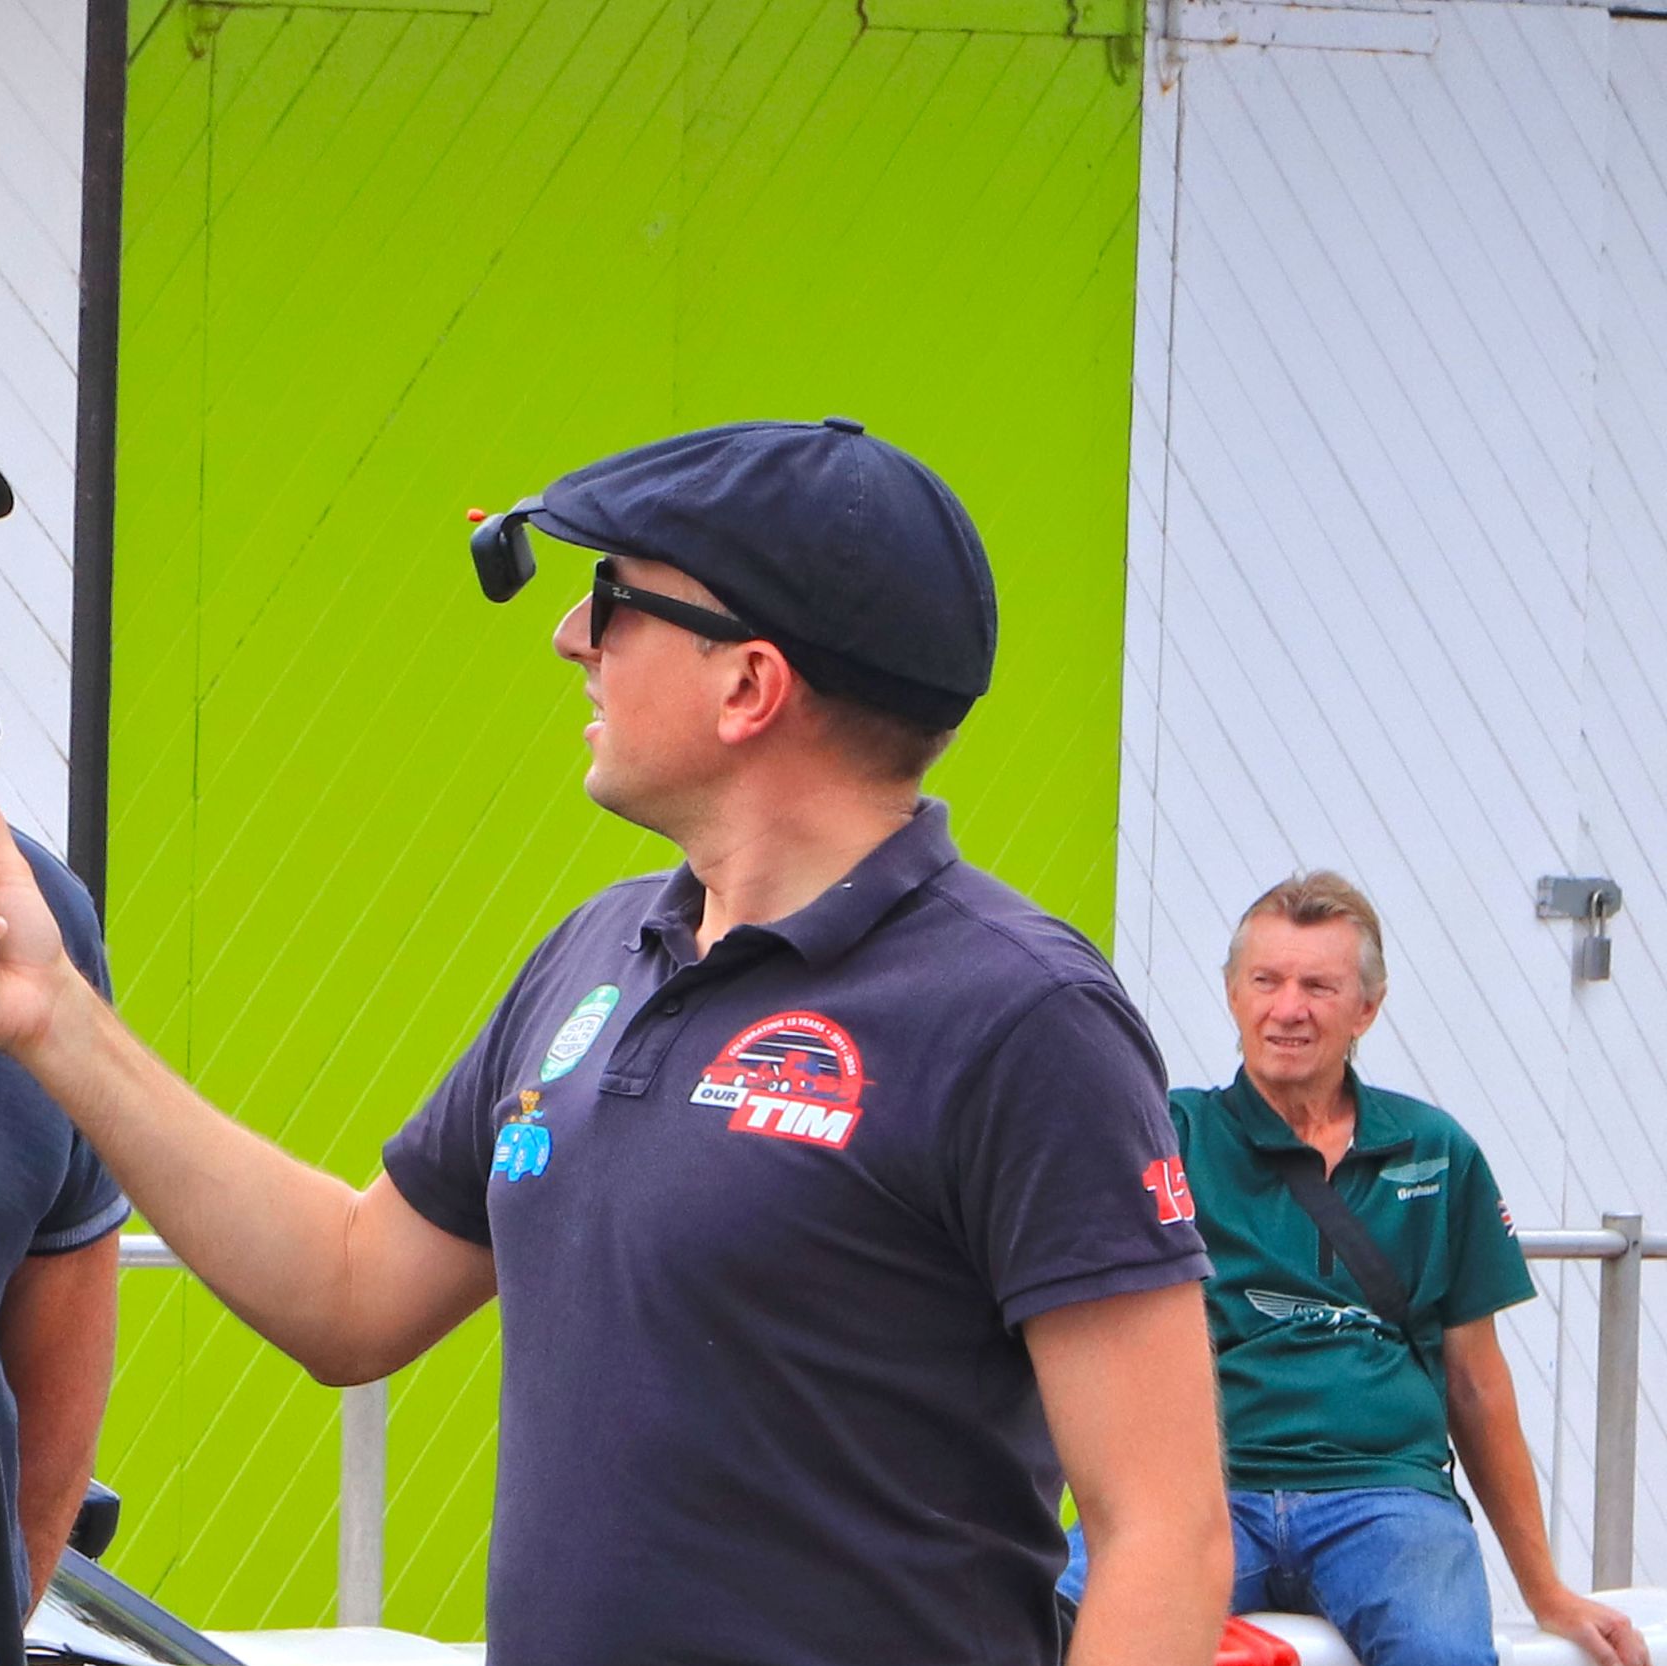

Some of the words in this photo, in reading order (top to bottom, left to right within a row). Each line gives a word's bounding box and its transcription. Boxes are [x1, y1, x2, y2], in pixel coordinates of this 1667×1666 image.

[728, 1019, 784, 1056] CELEBRATING
[798, 1017, 826, 1032] YEARS
[700, 1088, 738, 1103] OUR
[747, 1095, 853, 1143] TIM
